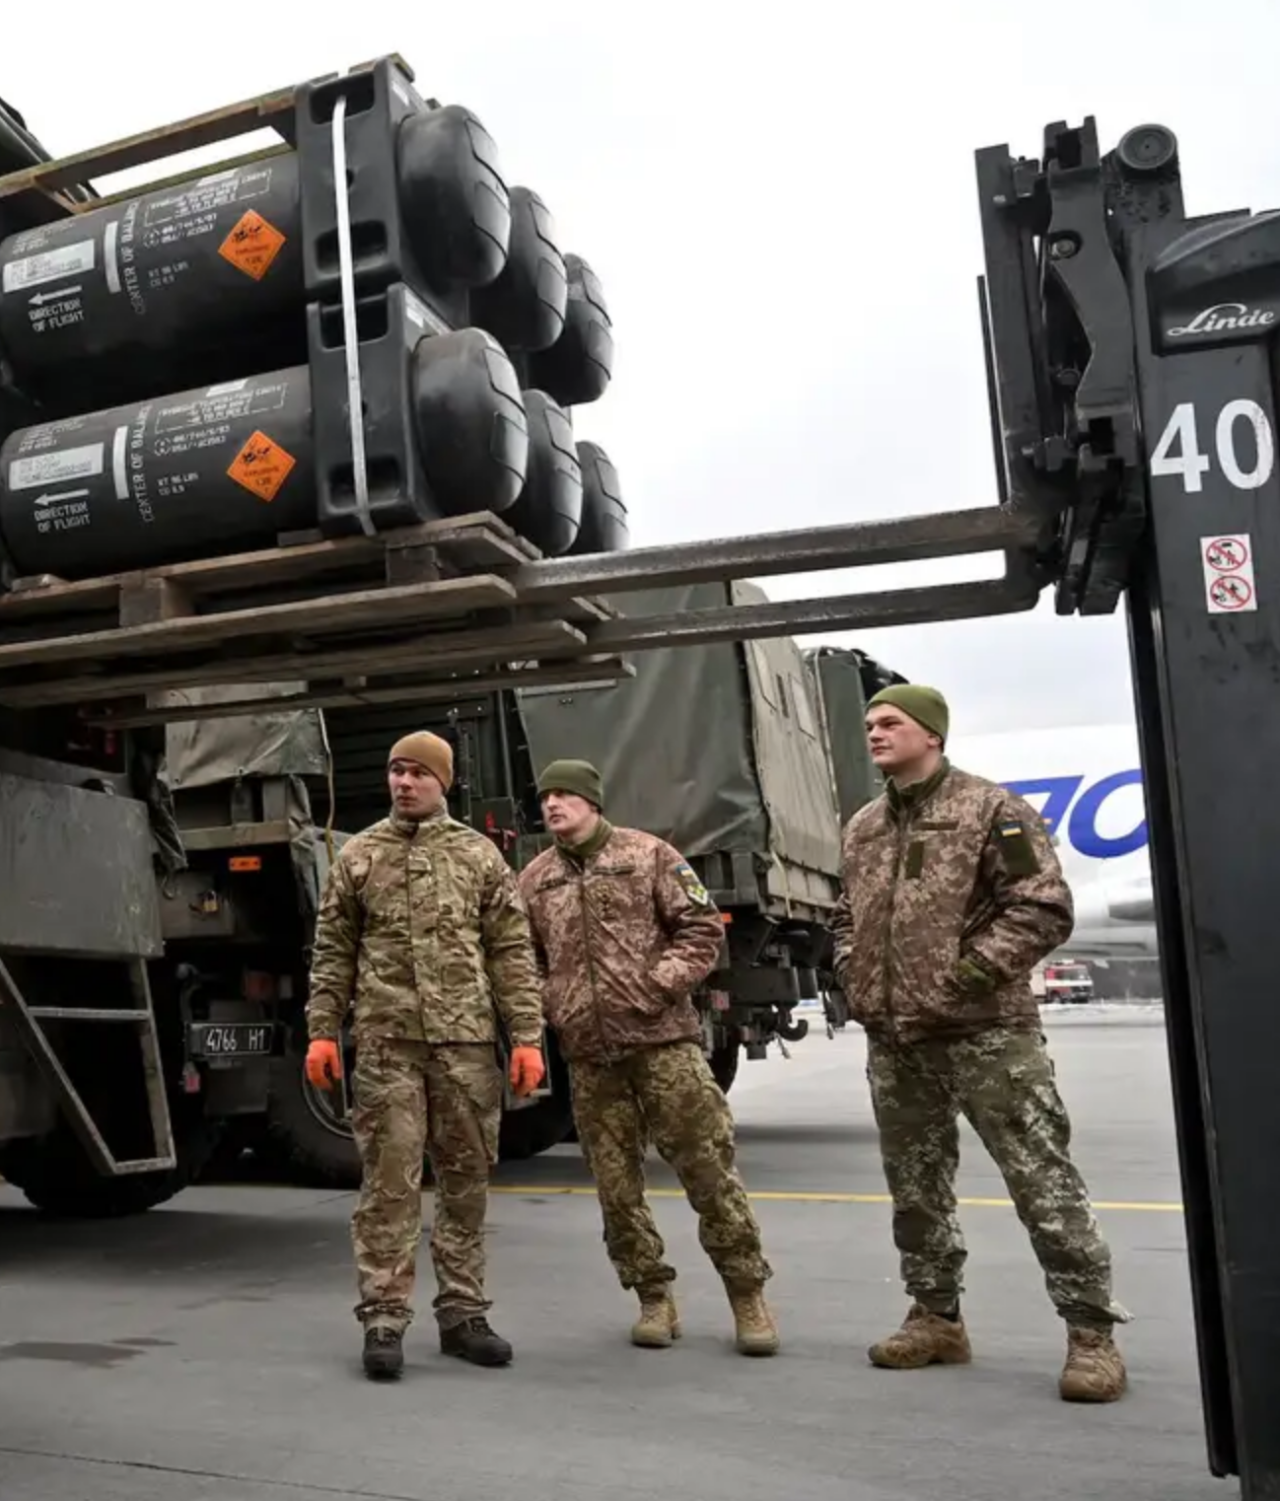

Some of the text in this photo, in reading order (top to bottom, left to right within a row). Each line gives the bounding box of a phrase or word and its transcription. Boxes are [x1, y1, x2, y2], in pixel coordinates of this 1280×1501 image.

[121, 246, 134, 263] OF
[28, 298, 81, 321] DIRECTION
[1167, 303, 1274, 336] Linde
[32, 310, 85, 332] OF FLIGHT
[1150, 399, 1274, 493] 40
[131, 453, 143, 469] OF
[132, 473, 154, 522] CENTER
[34, 501, 88, 521] DIRECTION
[37, 514, 91, 533] OF FLIGHT
[206, 1028, 265, 1052] 4766 H1
